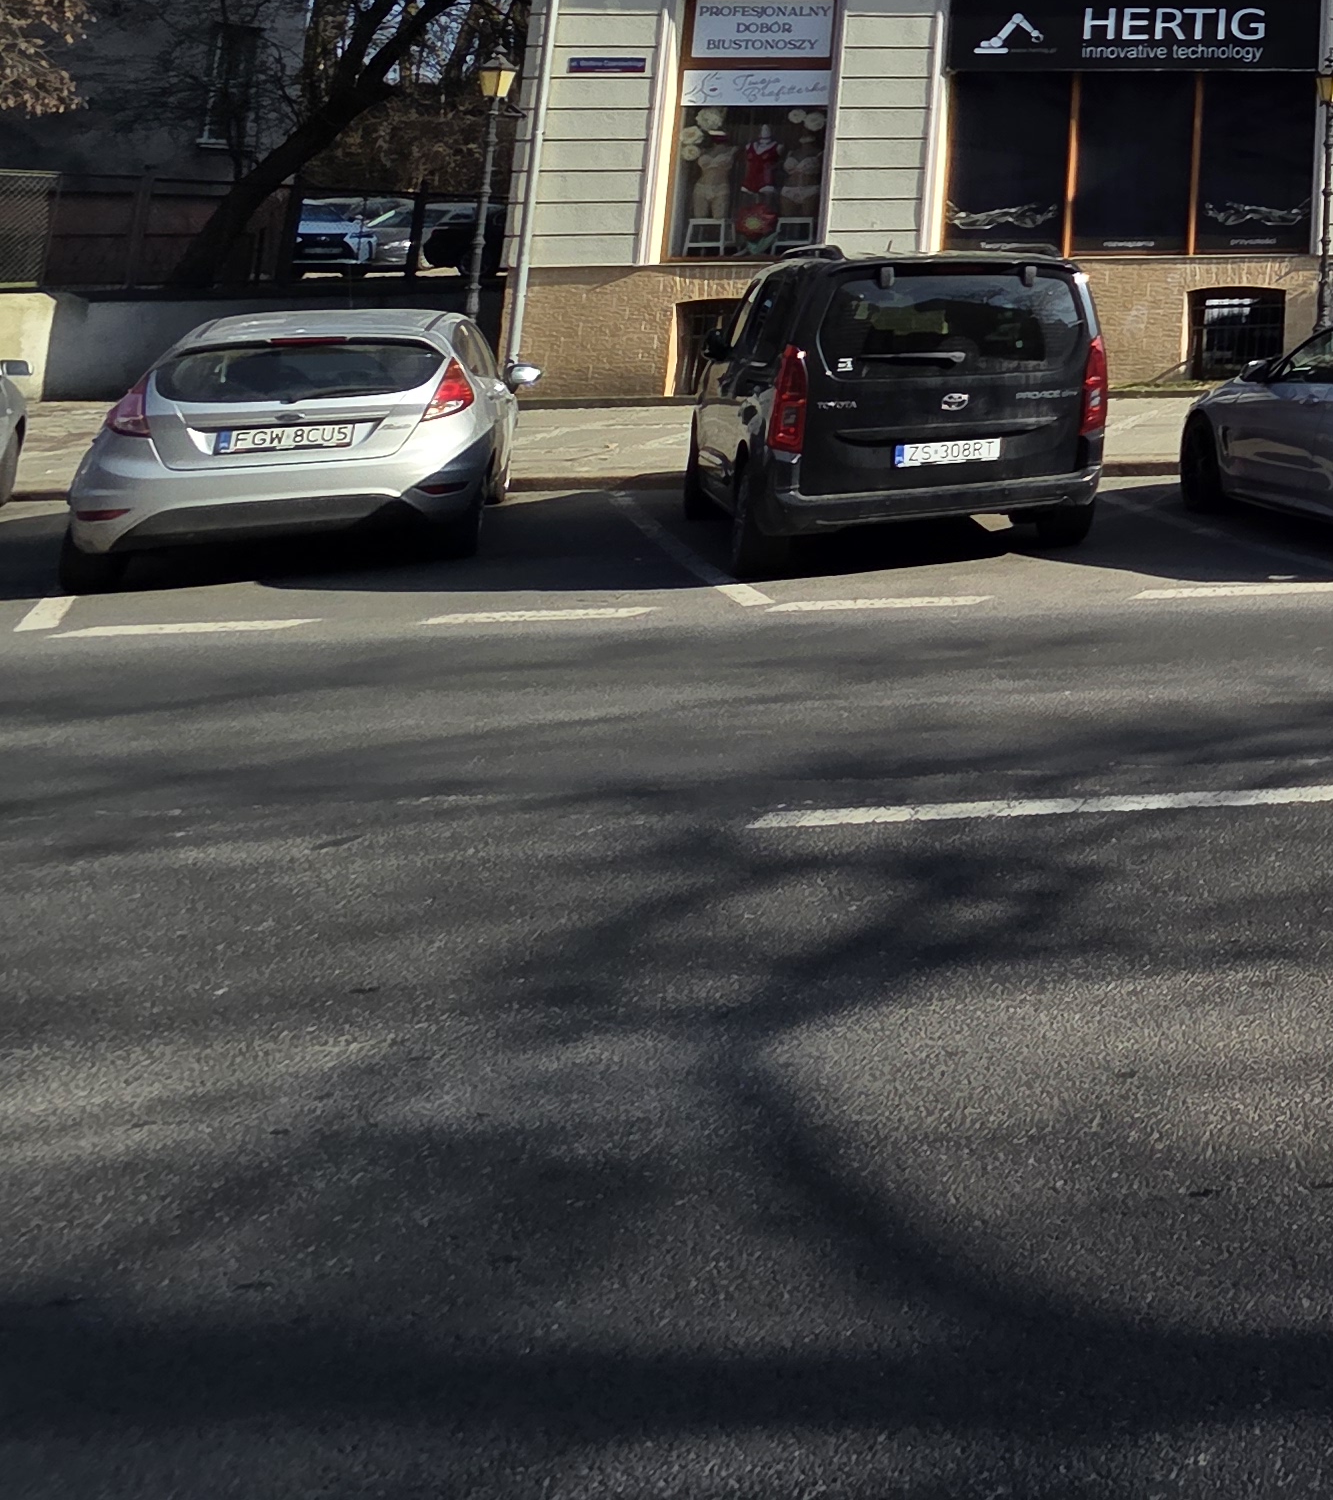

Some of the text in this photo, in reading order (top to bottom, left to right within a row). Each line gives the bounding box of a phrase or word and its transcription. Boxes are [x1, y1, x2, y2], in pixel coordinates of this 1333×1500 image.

[699, 5, 831, 18] PROFESJONALNY
[736, 20, 793, 33] DOBÓR
[1082, 7, 1266, 40] HERTIG
[706, 38, 819, 50] BIUSTONOSZY
[1081, 43, 1264, 62] innovative technology
[733, 74, 781, 91] Twoja
[817, 401, 857, 409] TOYOTA
[234, 426, 349, 447] FGW 8CU5
[908, 441, 995, 462] ZS 308RT
